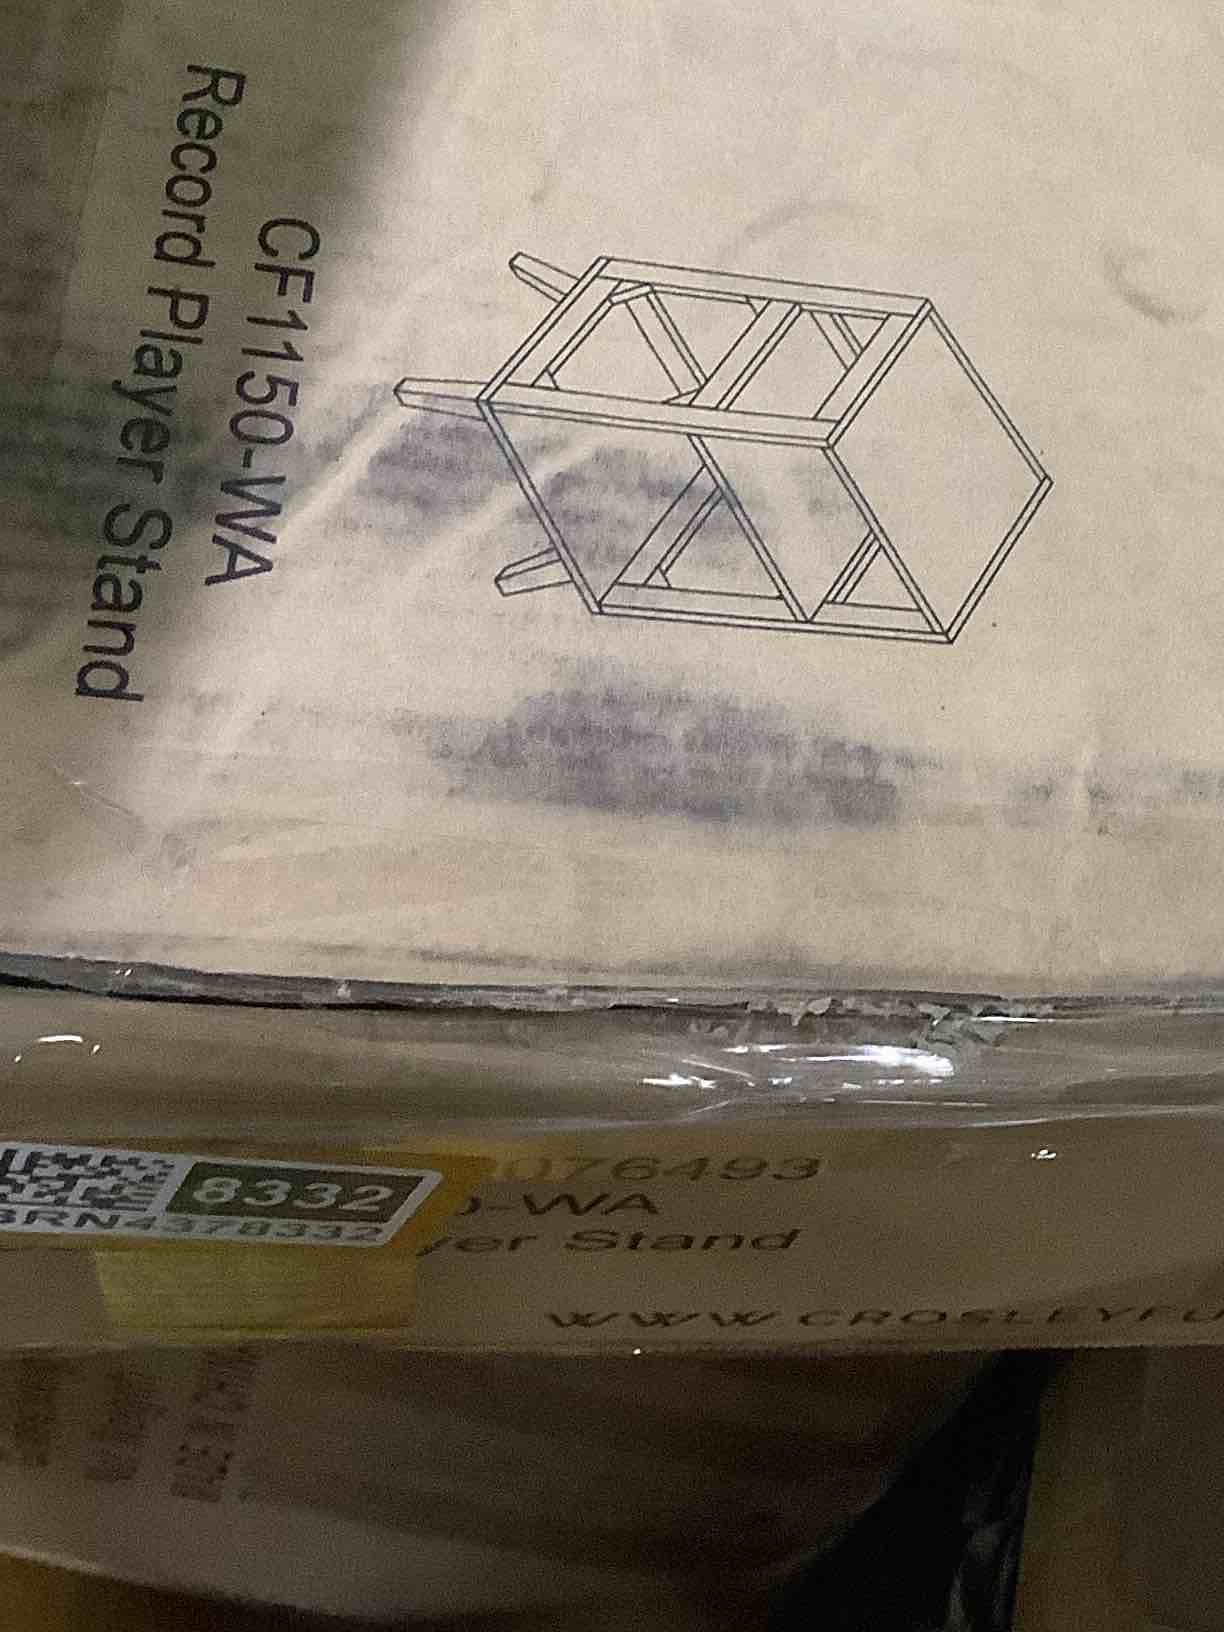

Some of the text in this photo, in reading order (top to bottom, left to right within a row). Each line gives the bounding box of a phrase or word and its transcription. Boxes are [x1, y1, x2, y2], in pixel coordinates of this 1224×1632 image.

[73, 64, 247, 703] Record Player Stand
[203, 216, 321, 586] CF1150-WA
[192, 1175, 395, 1212] 8332
[561, 1228, 802, 1251] Stand
